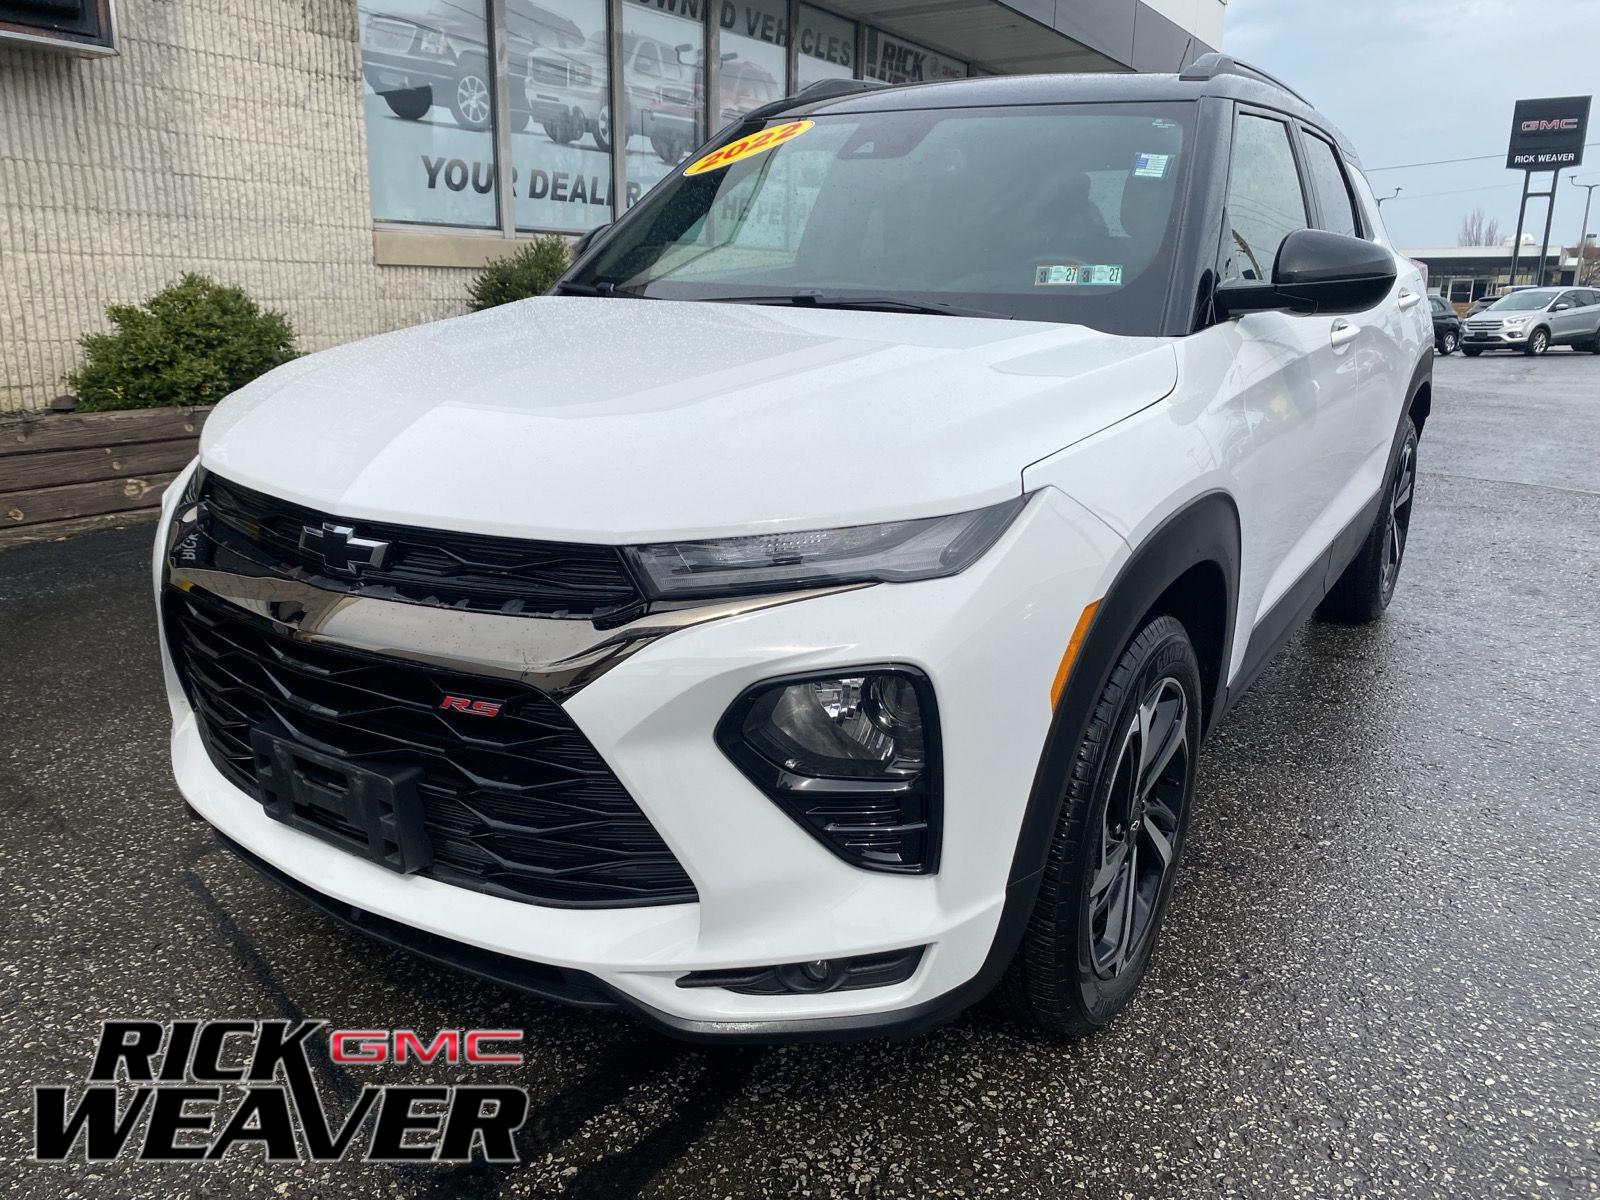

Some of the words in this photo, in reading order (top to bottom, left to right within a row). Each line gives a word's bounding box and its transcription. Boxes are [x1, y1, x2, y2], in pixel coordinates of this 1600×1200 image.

[746, 8, 851, 66] VEHCLES
[1521, 118, 1578, 131] GMC
[696, 122, 802, 172] 2022
[1514, 154, 1536, 163] RICK
[1538, 153, 1575, 162] WEAVER
[1066, 267, 1077, 281] 27
[1109, 267, 1120, 281] 27
[439, 695, 503, 718] RS
